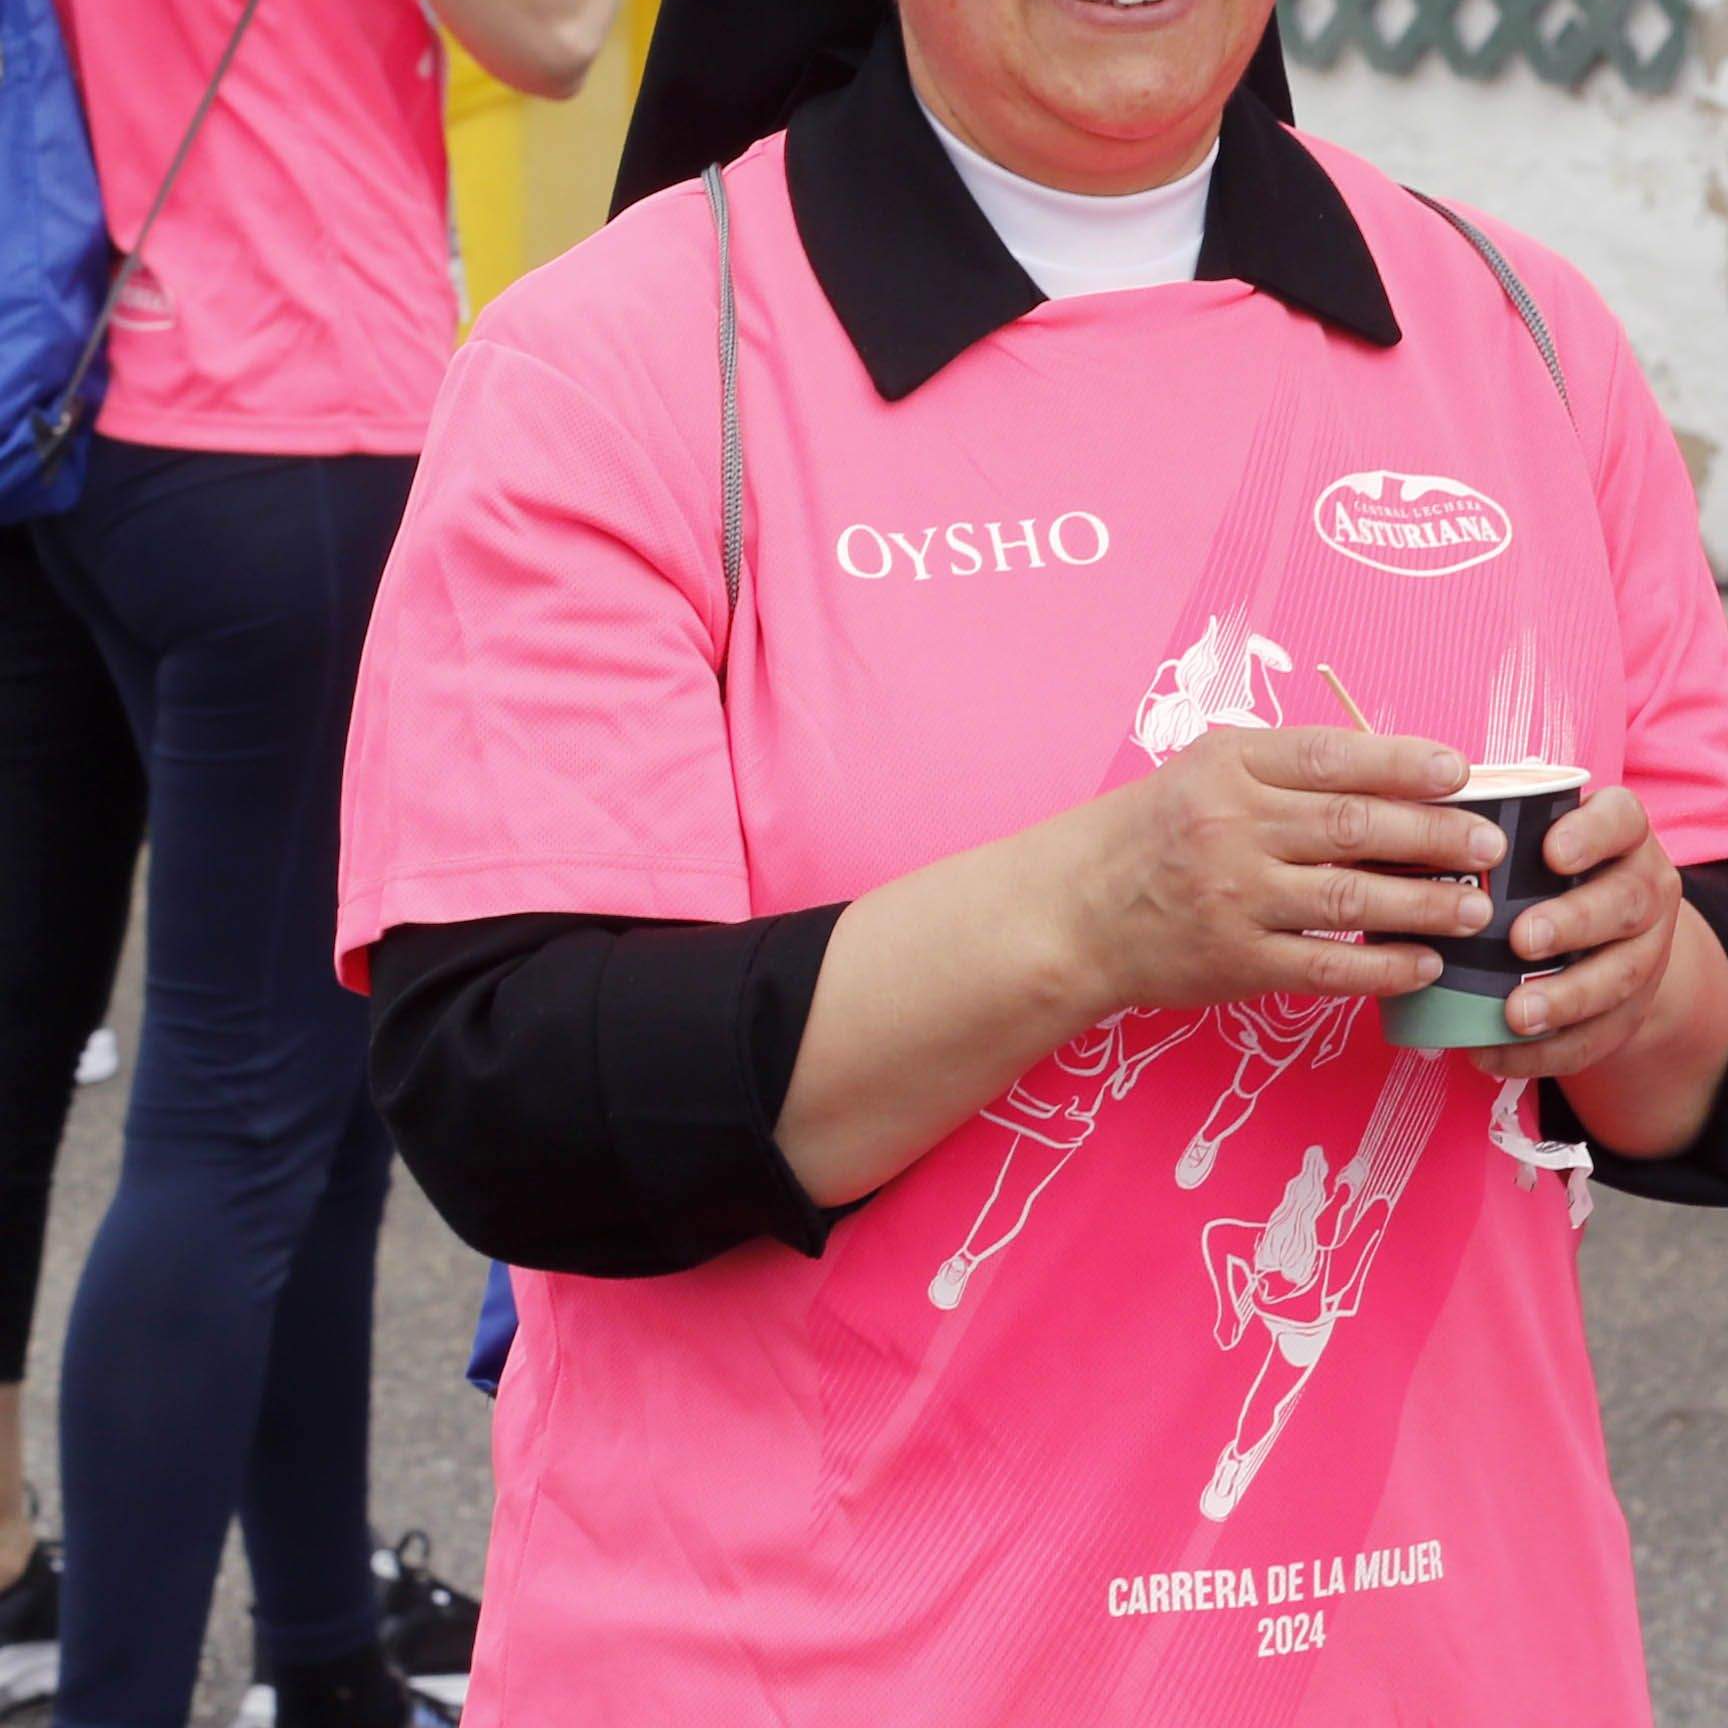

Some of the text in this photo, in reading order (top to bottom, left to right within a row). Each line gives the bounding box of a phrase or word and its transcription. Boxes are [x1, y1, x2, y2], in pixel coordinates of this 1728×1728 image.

[836, 510, 1112, 581] OYSHO
[1334, 501, 1501, 549] ASTURIANA
[1107, 1539, 1444, 1617] CARRERA DE LA MUJER
[1257, 1610, 1326, 1658] 2024
